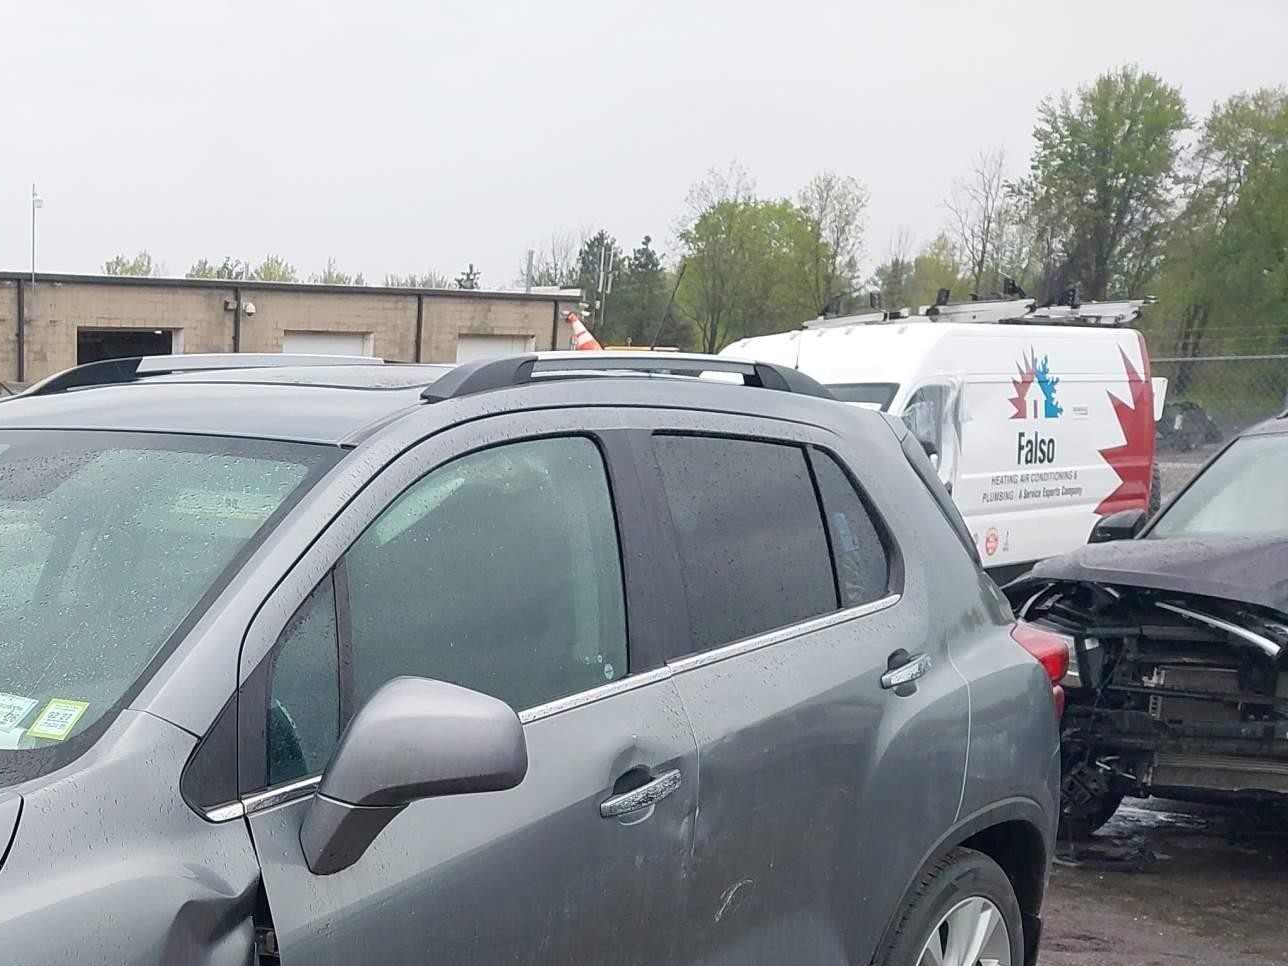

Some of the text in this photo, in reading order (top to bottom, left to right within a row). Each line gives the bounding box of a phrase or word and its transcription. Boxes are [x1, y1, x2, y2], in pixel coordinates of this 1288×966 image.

[1017, 431, 1056, 465] Falso
[991, 473, 1018, 486] HEATING
[1020, 473, 1030, 484] AIR
[1031, 470, 1073, 483] CONDITIONING
[982, 490, 1014, 503] PLUMBING
[1023, 488, 1041, 499] Service
[1061, 486, 1083, 498] Company
